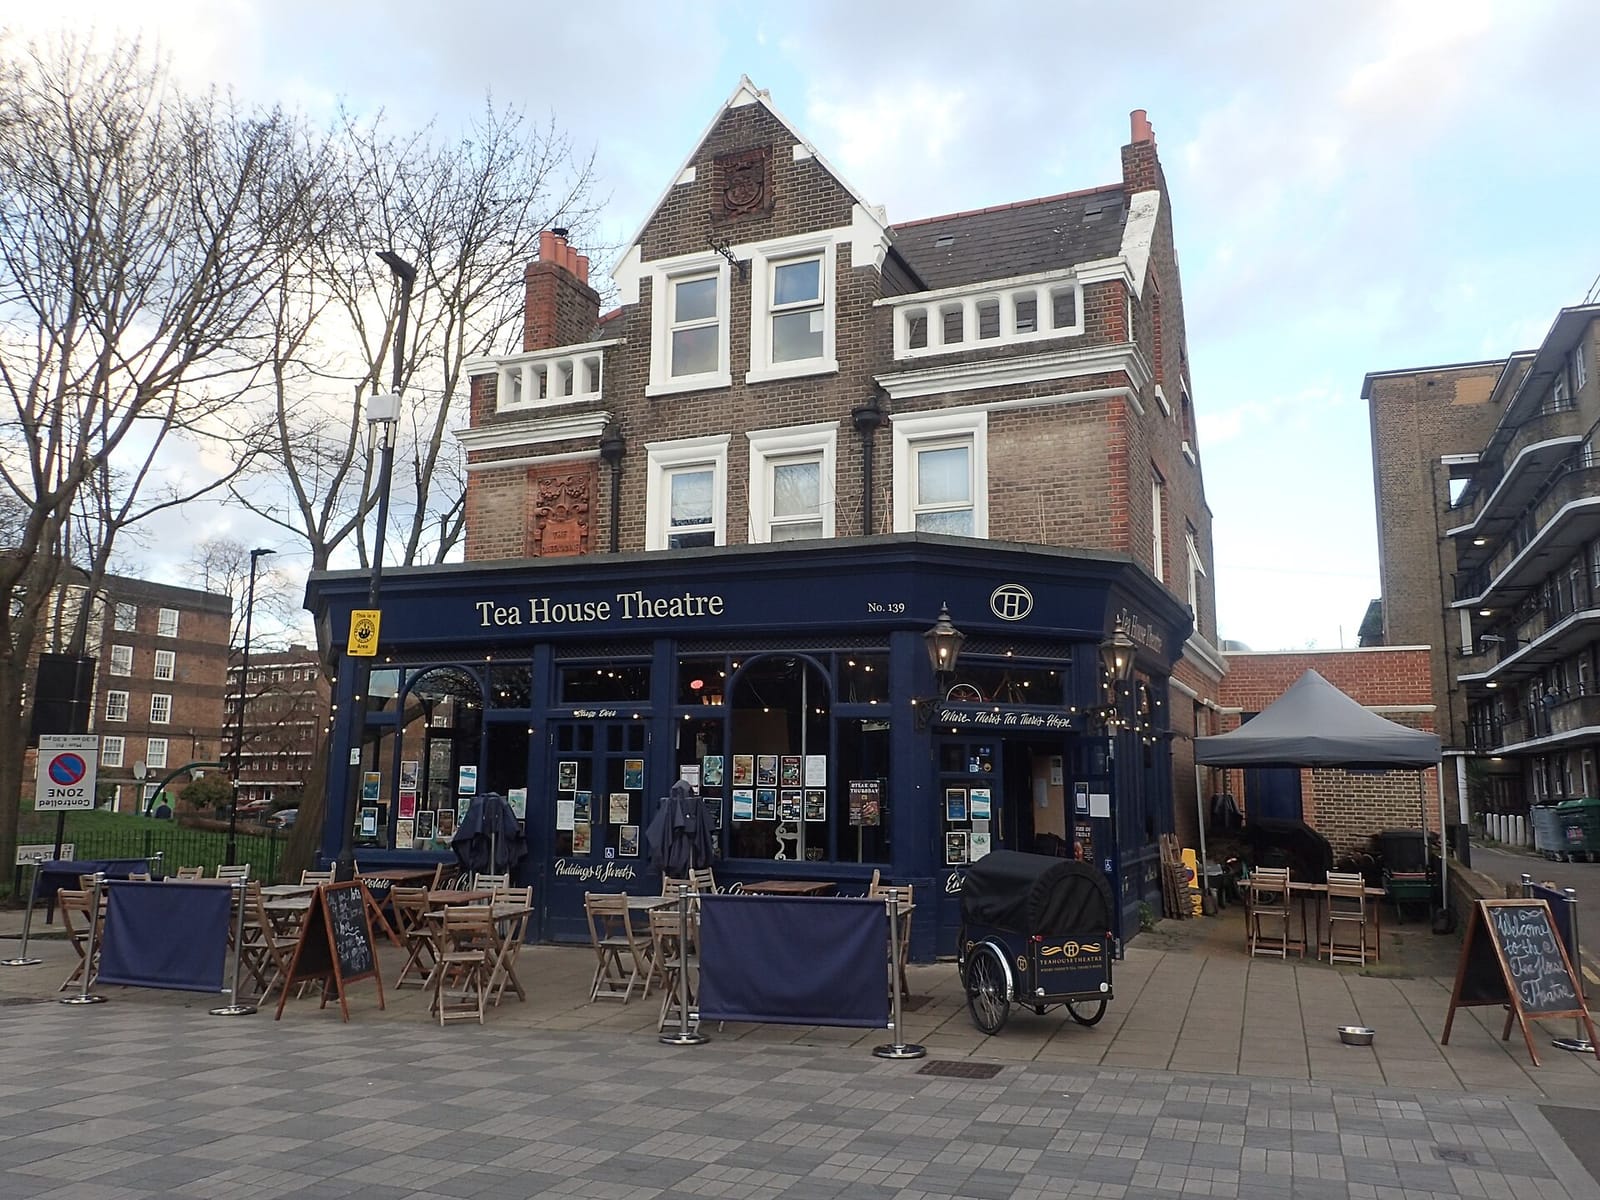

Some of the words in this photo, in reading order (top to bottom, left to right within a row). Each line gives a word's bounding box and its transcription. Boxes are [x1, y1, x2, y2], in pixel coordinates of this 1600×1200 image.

[475, 601, 522, 626] Tea
[528, 598, 611, 624] House
[616, 590, 724, 619] Theatre
[867, 602, 886, 613] No.
[888, 602, 905, 613] 139
[1003, 712, 1018, 725] Tea
[1046, 713, 1072, 728] Hope
[48, 788, 84, 797] ZONE
[39, 799, 90, 807] Controlled
[44, 850, 72, 859] STET
[554, 858, 594, 880] Puddings
[600, 861, 636, 882] Sweets
[1498, 912, 1550, 938] Welcome
[1504, 939, 1519, 955] to
[1521, 938, 1541, 955] the
